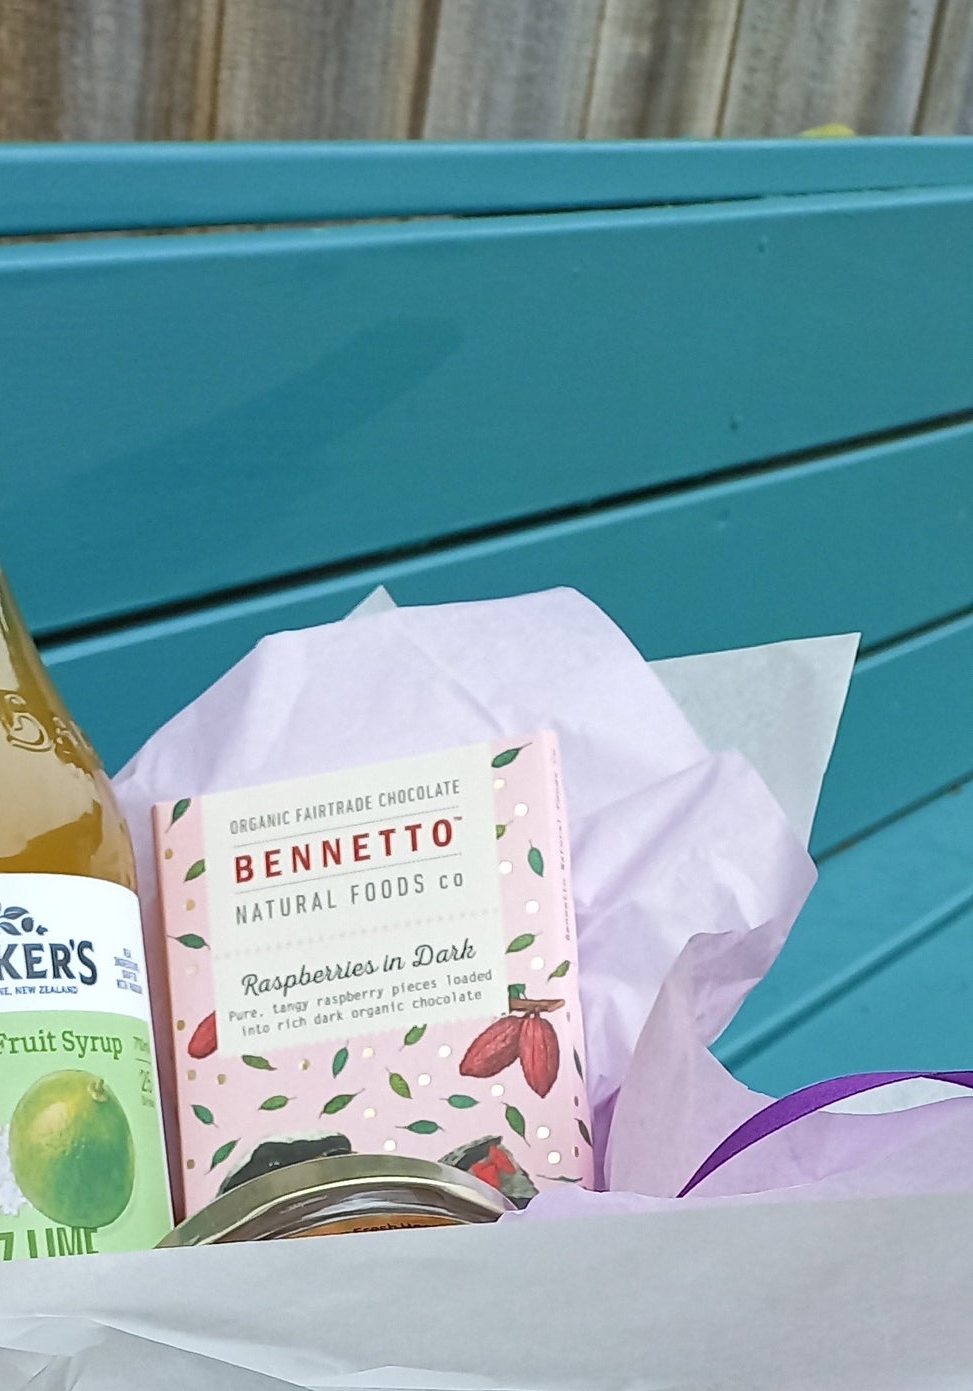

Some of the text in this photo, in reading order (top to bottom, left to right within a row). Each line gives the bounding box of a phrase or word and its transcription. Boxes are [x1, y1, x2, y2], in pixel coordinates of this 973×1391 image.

[229, 779, 460, 835] ORGANIC FAIRTRADE CHOCOLATE
[235, 889, 337, 925] NATURAL
[350, 873, 425, 904] FOODS
[15, 985, 38, 995] NEW
[39, 985, 78, 995] ZEALAND
[241, 937, 477, 997] Raspberries in Dark
[242, 991, 482, 1037] into rich dark organic chocolate
[272, 1000, 309, 1014] tangy
[317, 988, 384, 1006] raspberry
[392, 979, 437, 997] pieces
[447, 969, 492, 986] loaded
[61, 1030, 123, 1061] Syrup
